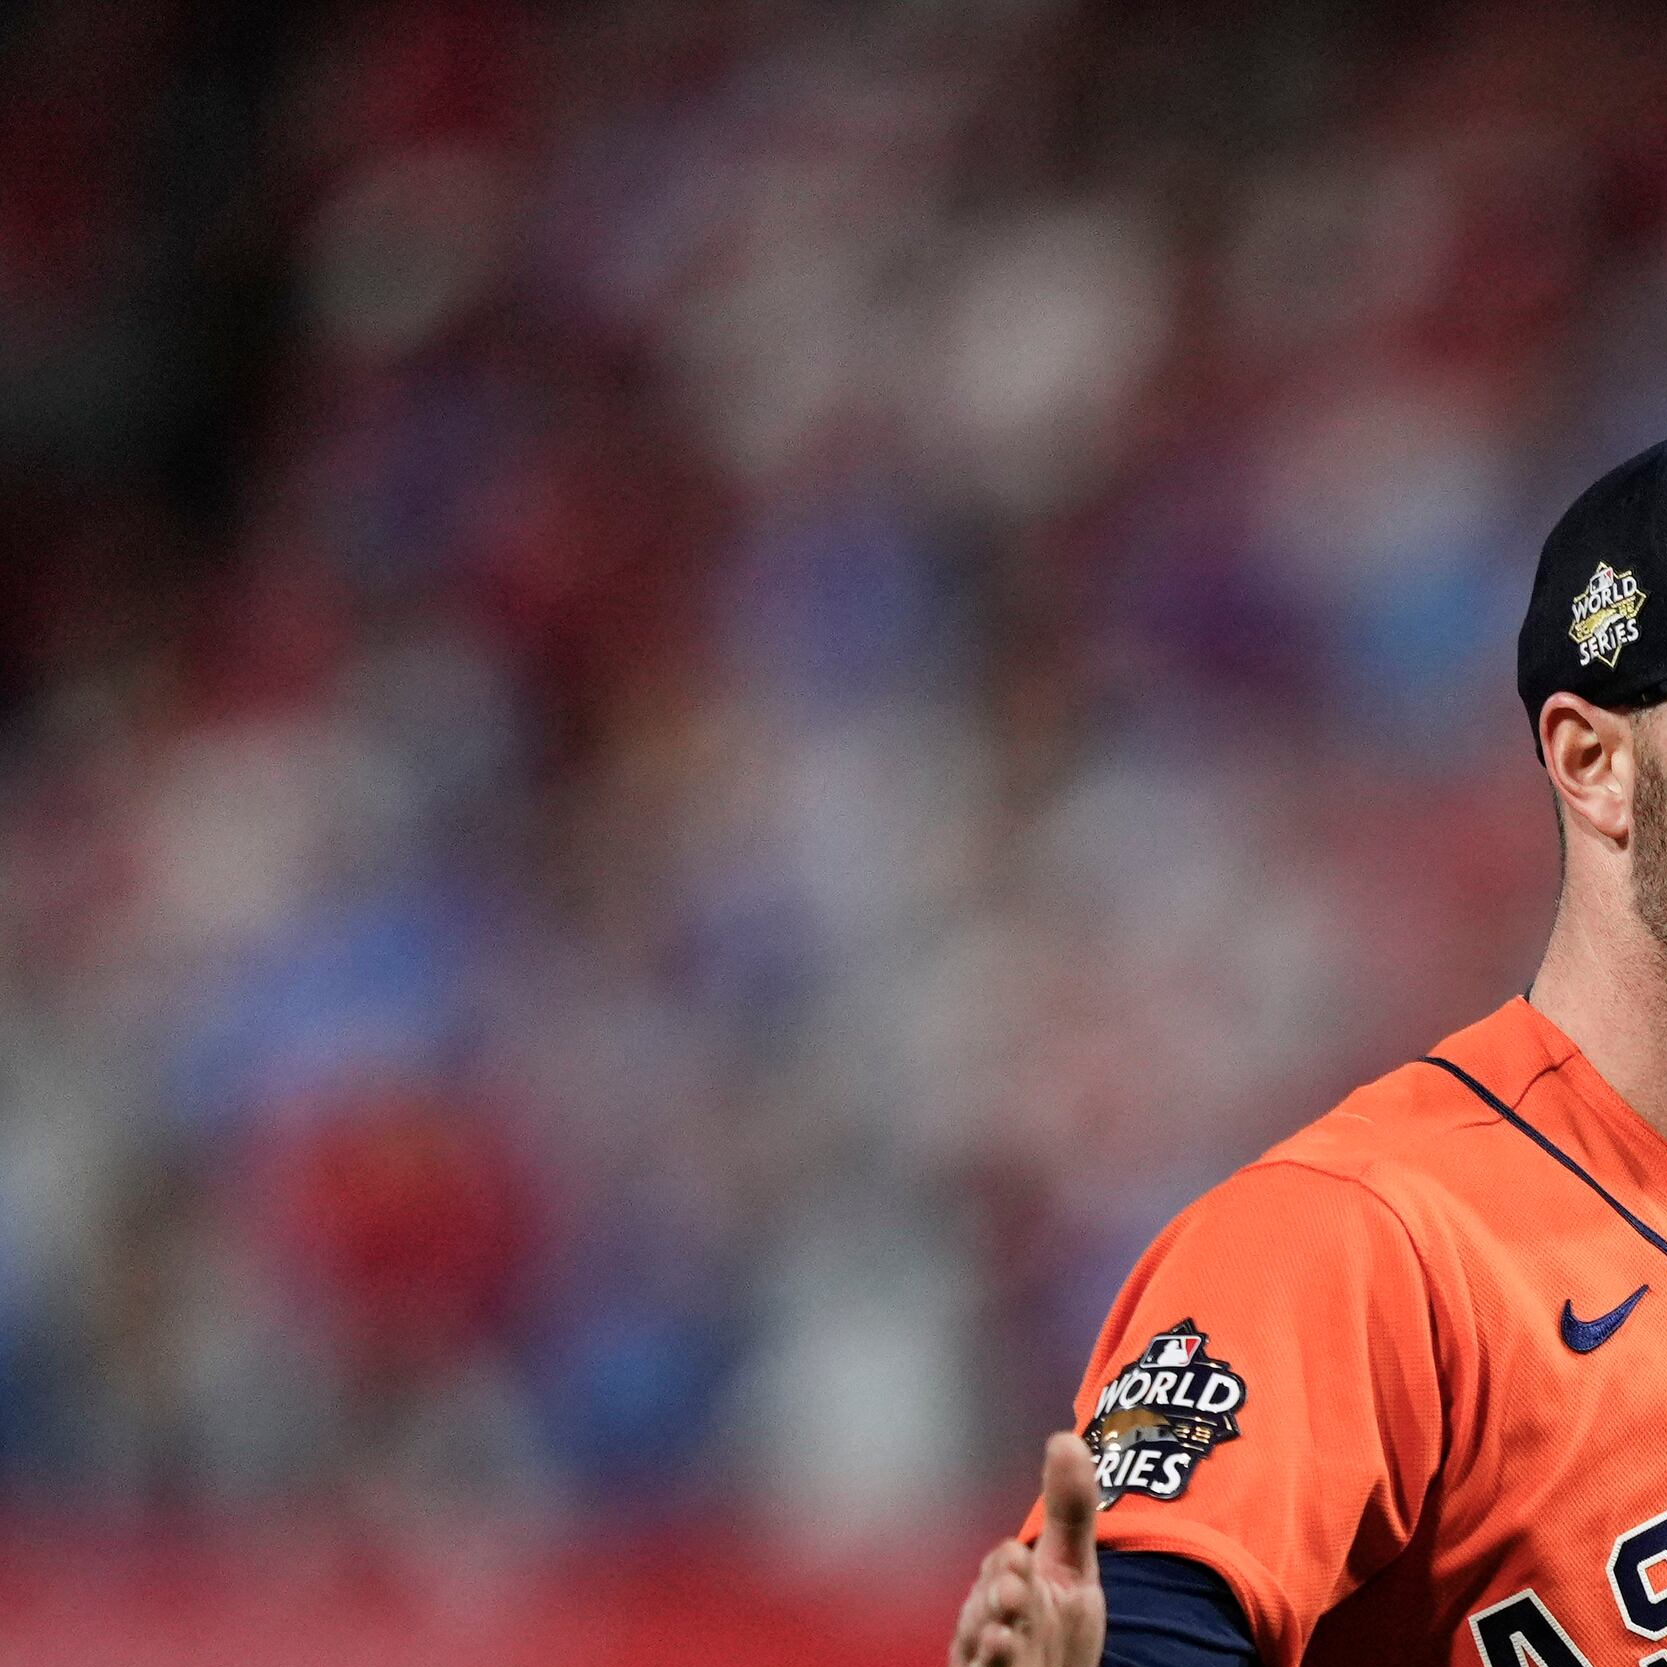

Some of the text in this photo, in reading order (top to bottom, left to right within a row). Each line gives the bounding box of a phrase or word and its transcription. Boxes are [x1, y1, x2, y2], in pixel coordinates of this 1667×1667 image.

[1572, 576, 1637, 623] WORLD
[1579, 618, 1640, 667] SERIES
[1094, 1369, 1243, 1419] WORLD
[1091, 1449, 1192, 1496] RIES
